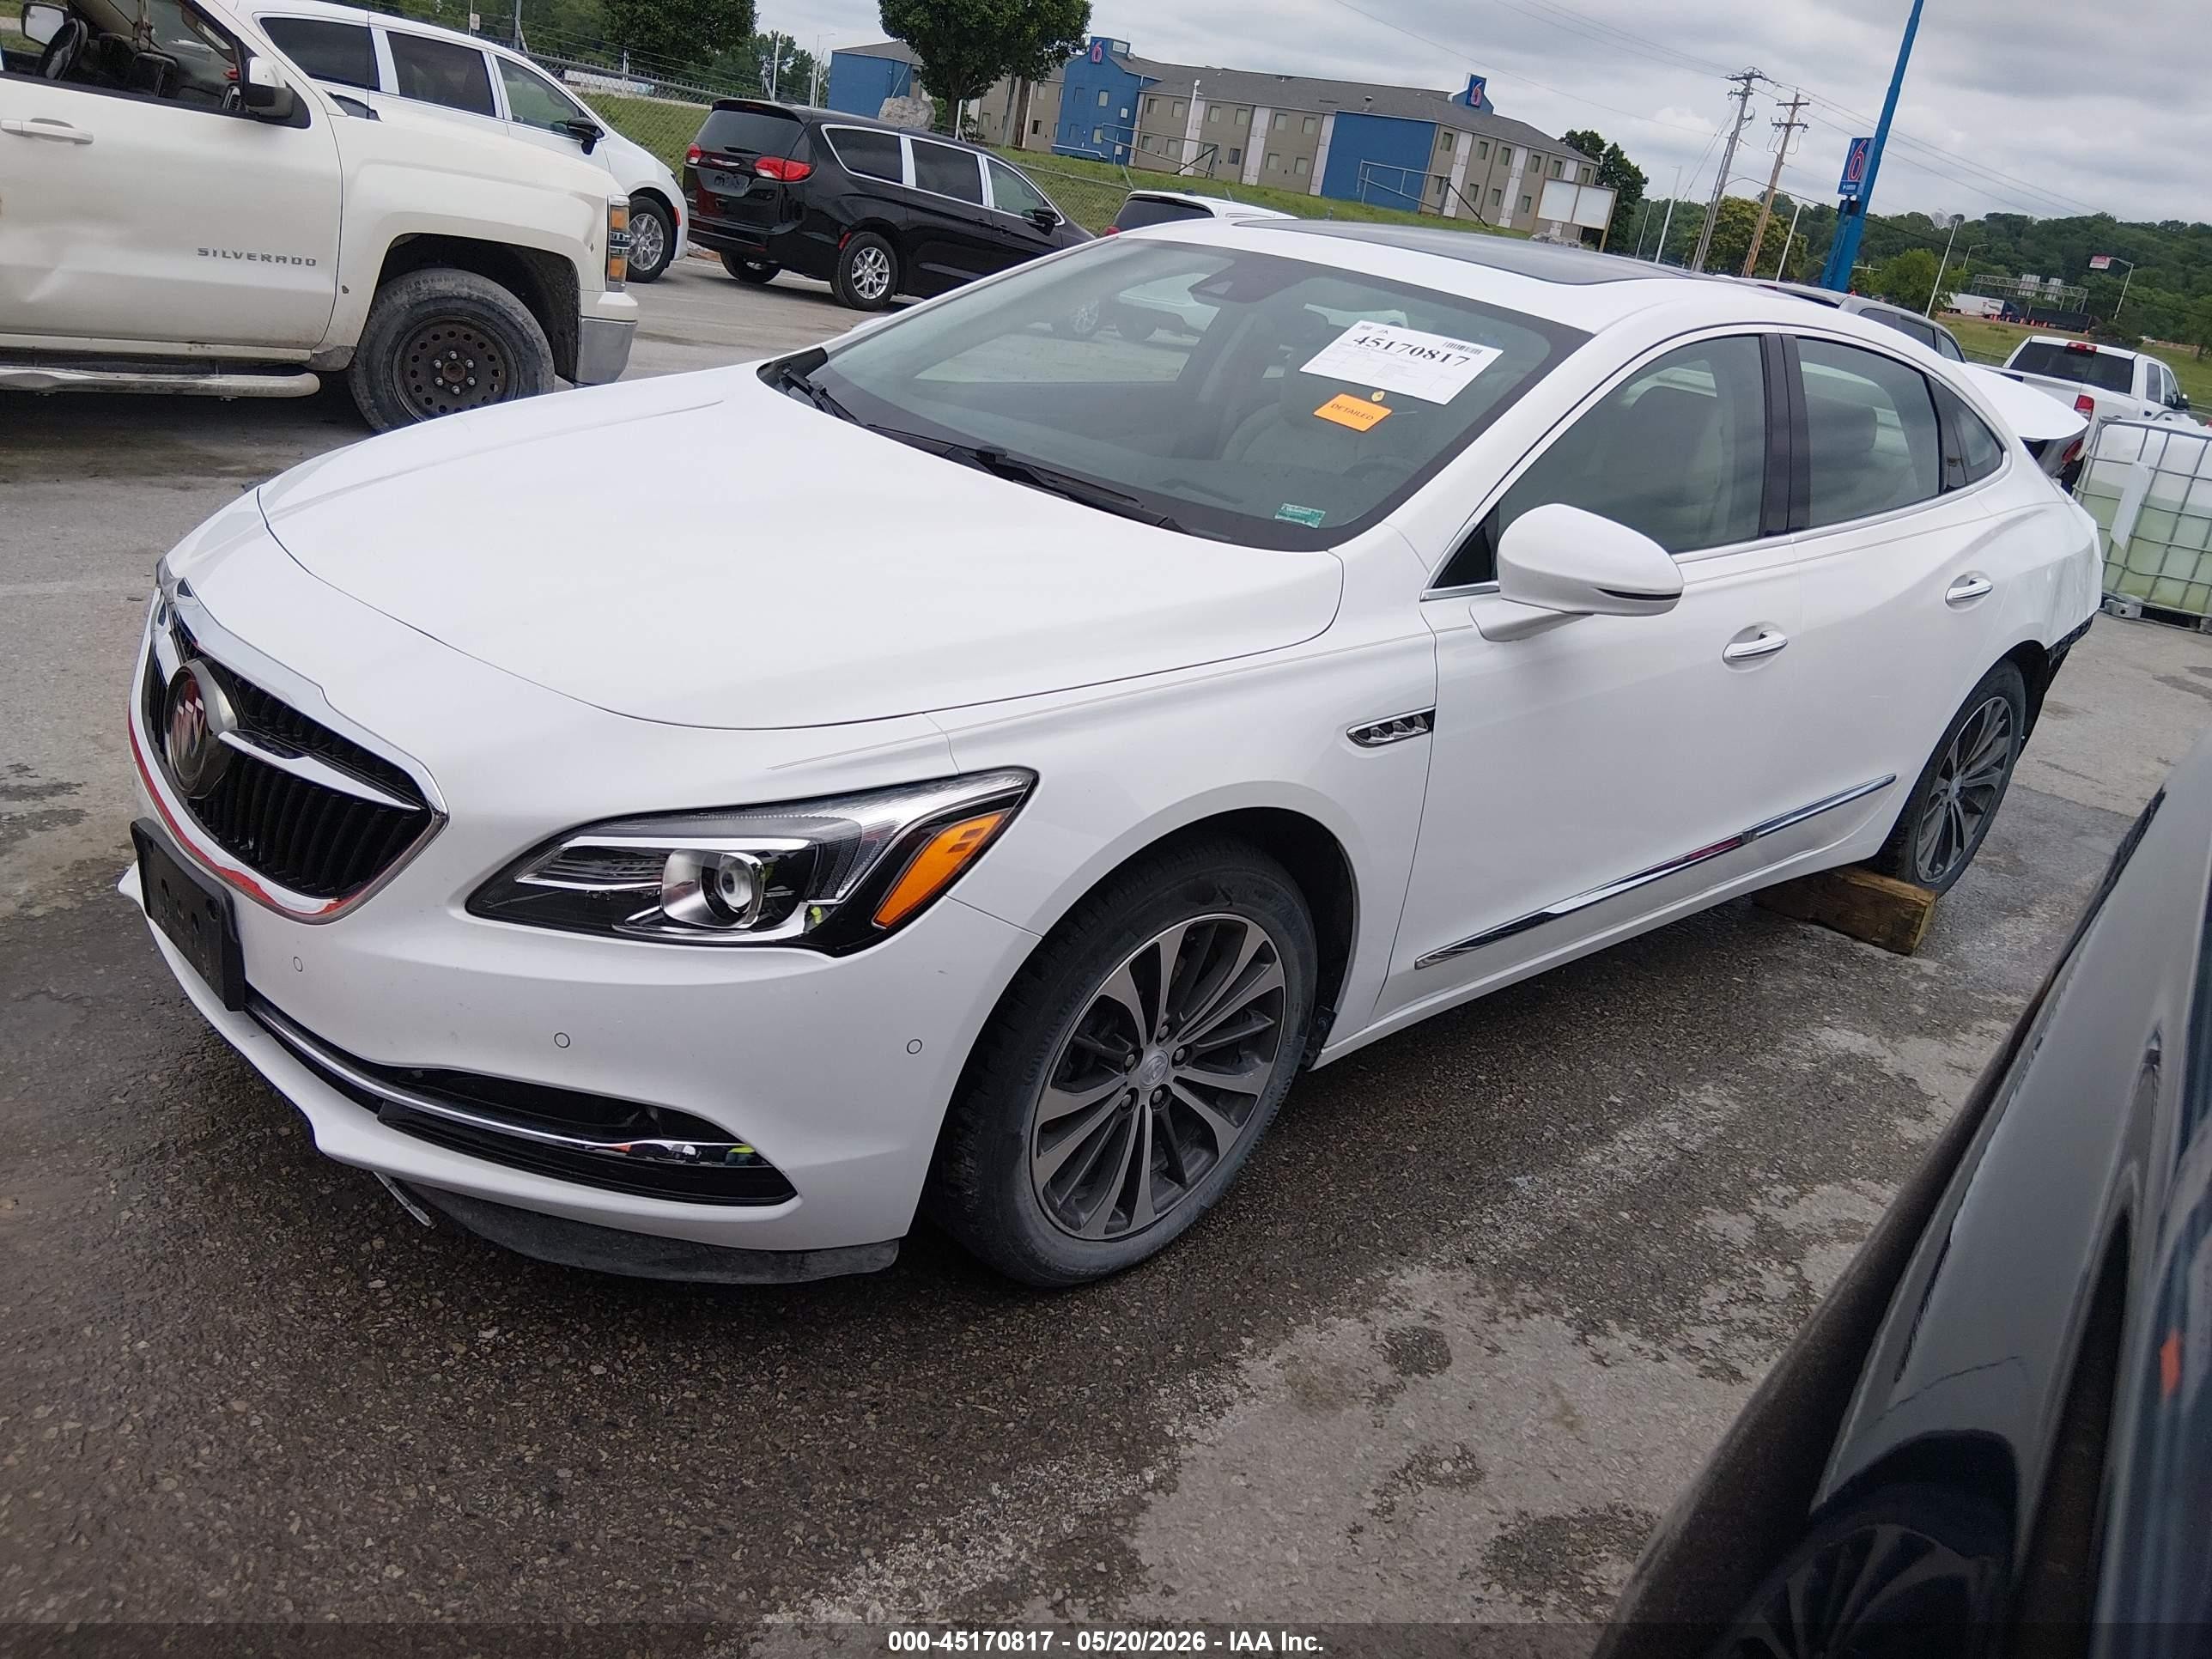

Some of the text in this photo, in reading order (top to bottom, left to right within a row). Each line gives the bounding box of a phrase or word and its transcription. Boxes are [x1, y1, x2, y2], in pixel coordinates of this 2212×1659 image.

[1091, 41, 1103, 63] 6
[1471, 82, 1482, 106] 6
[1848, 139, 1867, 181] 6
[198, 247, 317, 266] SILVERADO
[1353, 336, 1470, 367] 45170817
[1331, 403, 1374, 421] DETAILED
